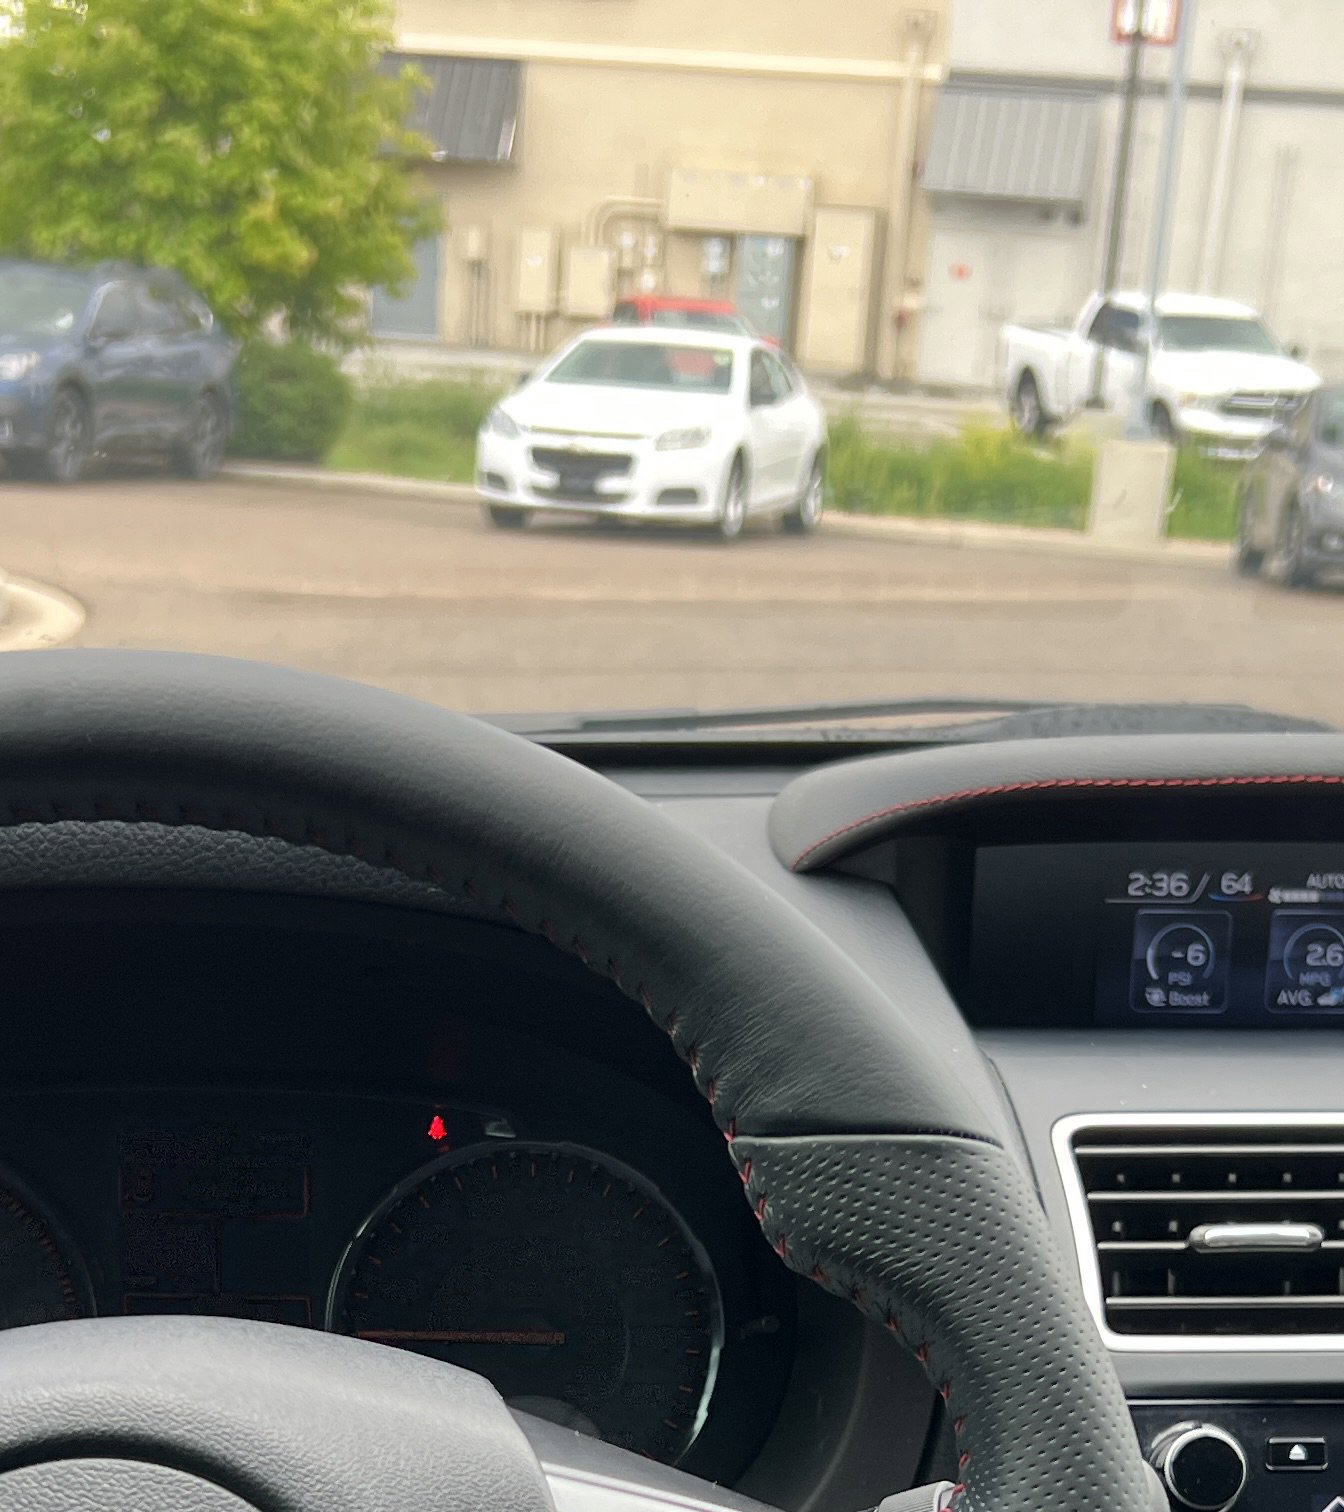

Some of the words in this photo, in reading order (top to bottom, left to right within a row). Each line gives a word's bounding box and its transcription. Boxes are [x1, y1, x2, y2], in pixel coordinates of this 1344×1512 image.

[1128, 871, 1189, 897] 2:36
[1221, 872, 1253, 895] 64
[1171, 943, 1207, 967] -6
